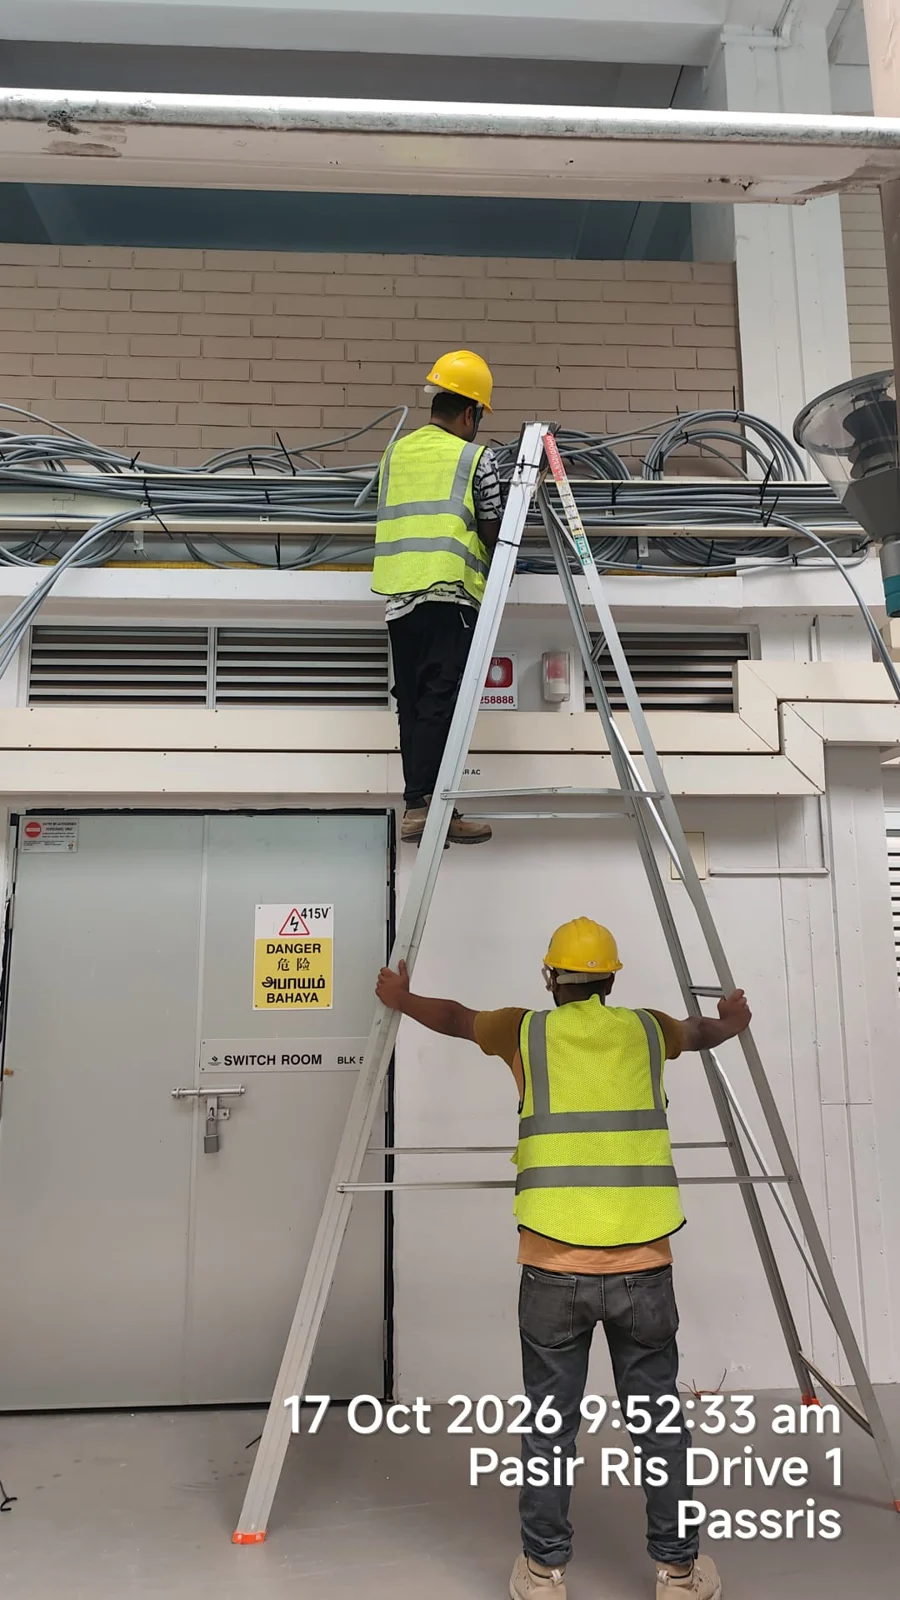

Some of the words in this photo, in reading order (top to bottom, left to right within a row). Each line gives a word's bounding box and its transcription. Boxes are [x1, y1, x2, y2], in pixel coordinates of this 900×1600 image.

[301, 908, 329, 919] 415V
[266, 943, 322, 955] DANGER
[261, 974, 326, 990] அபாயம்
[266, 992, 319, 1003] BAHAYA
[224, 1055, 276, 1066] SWITCH
[281, 1054, 323, 1065] ROOM
[337, 1056, 356, 1065] BLK
